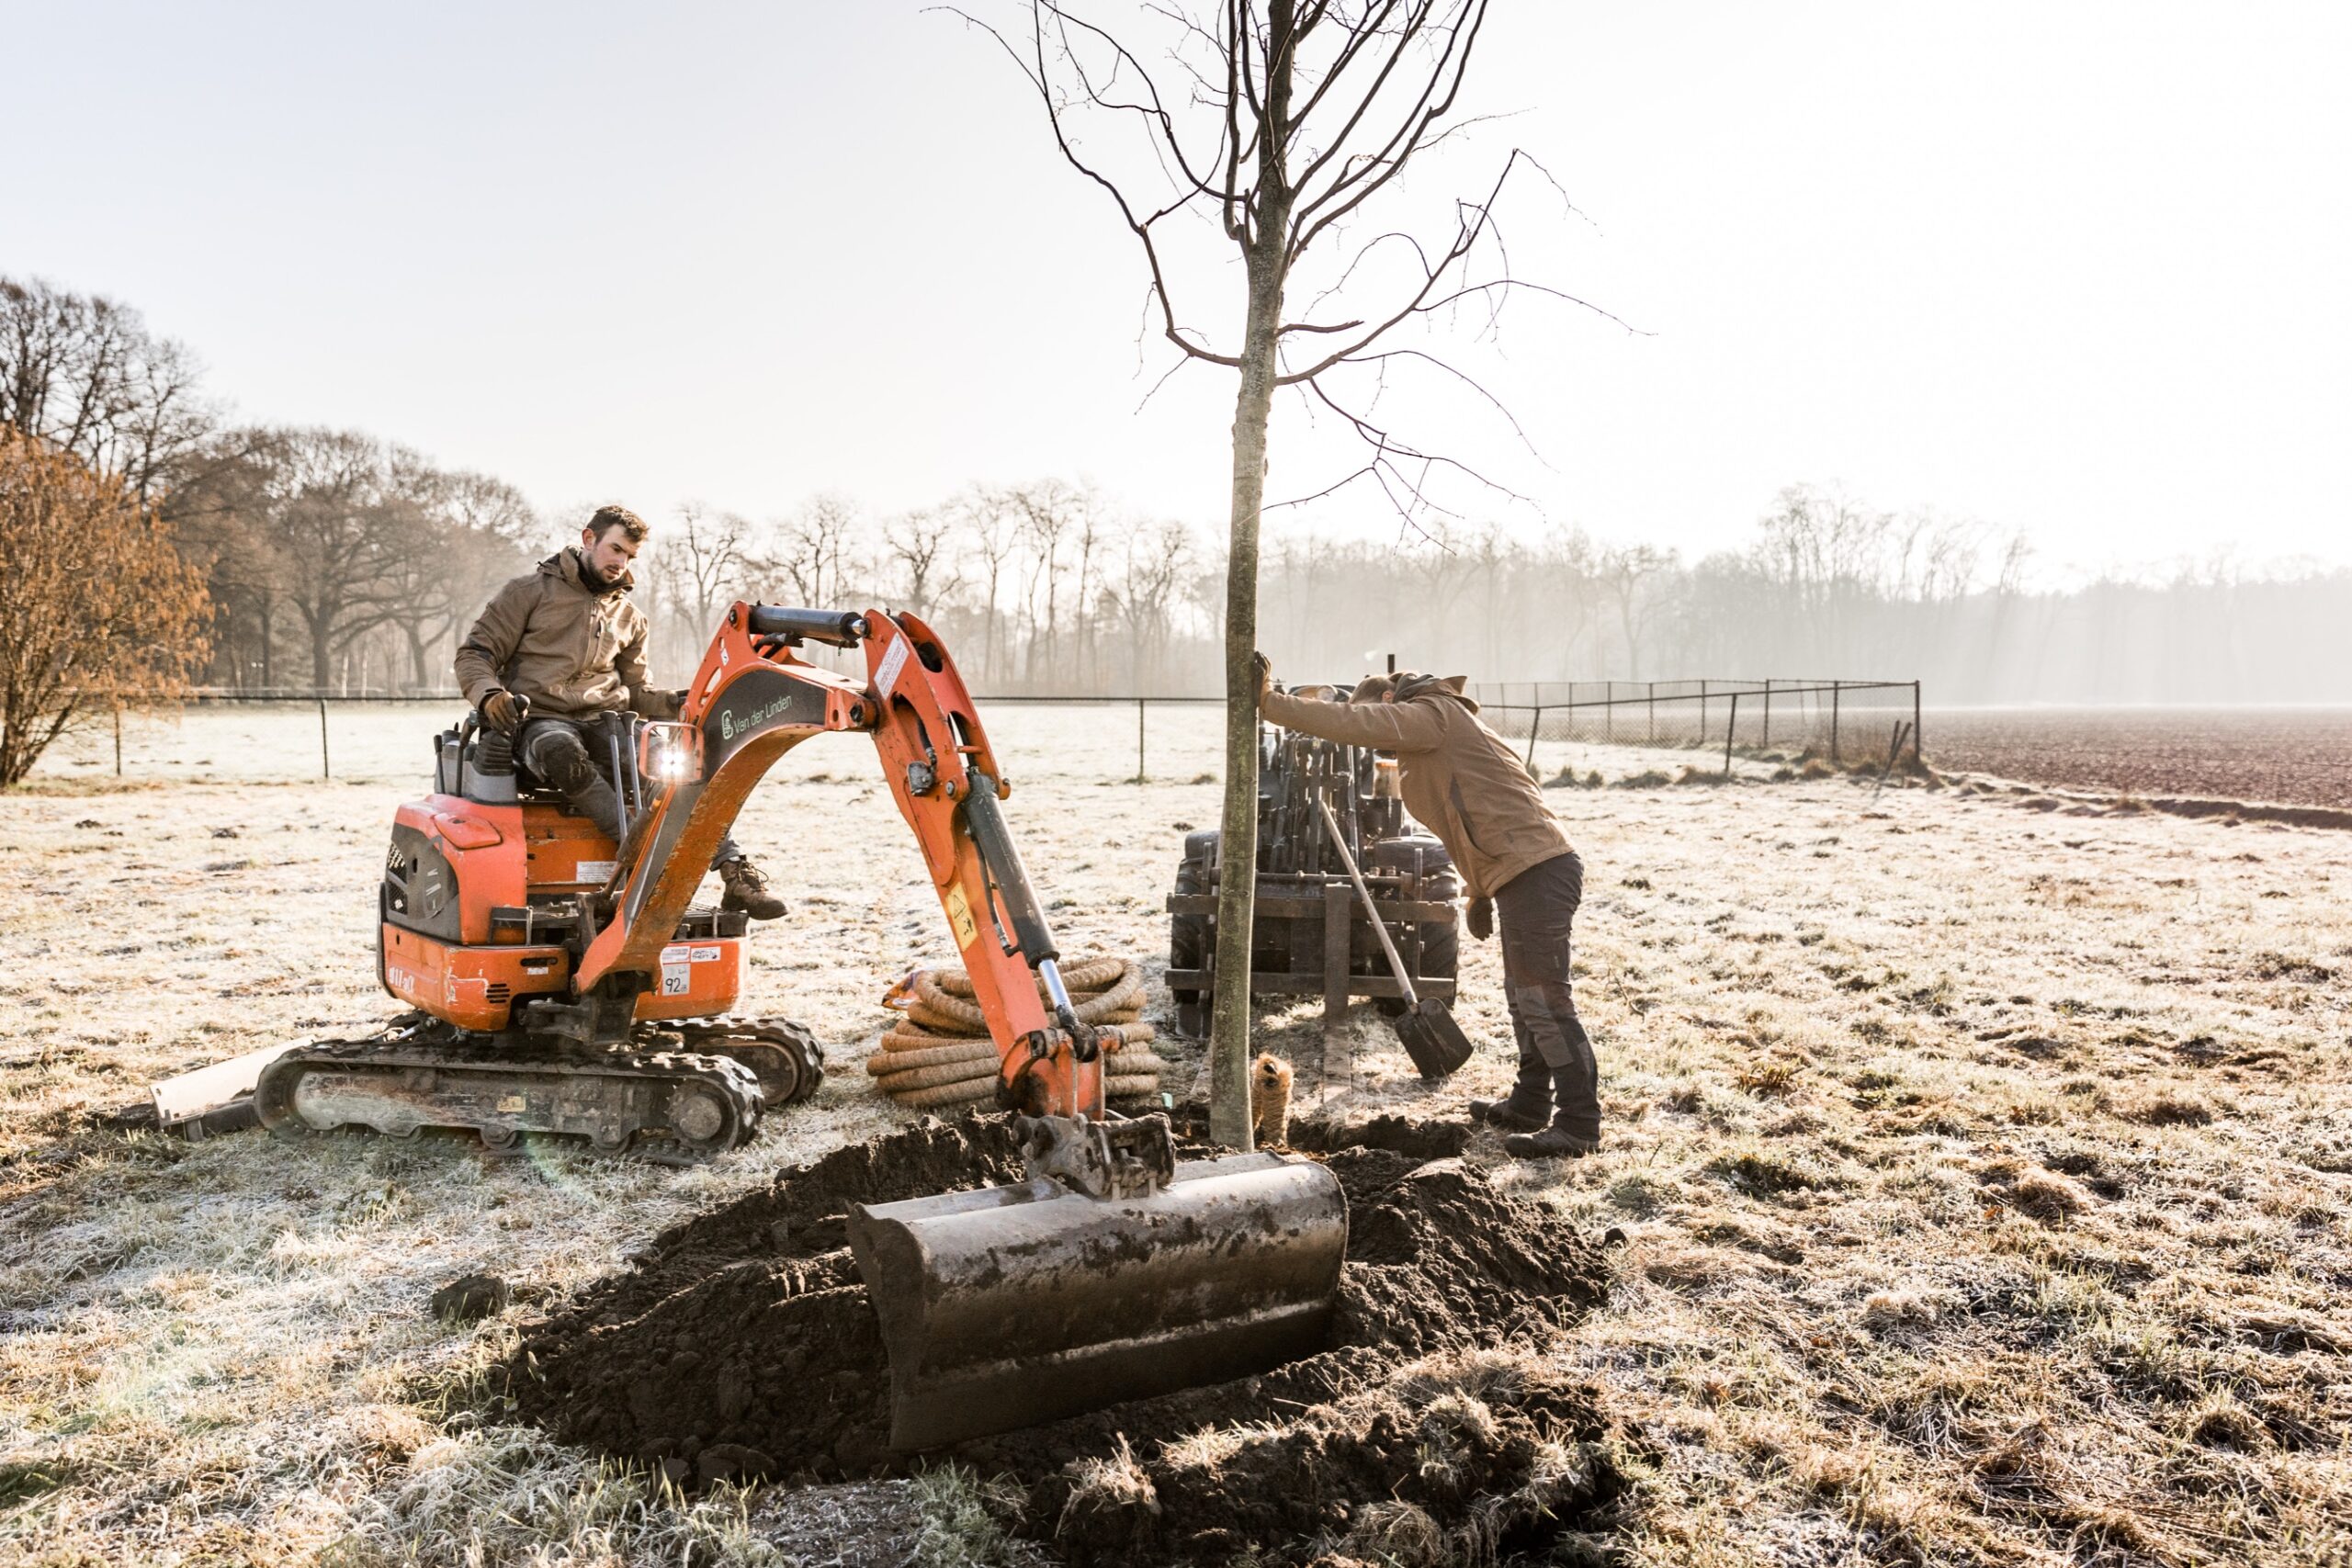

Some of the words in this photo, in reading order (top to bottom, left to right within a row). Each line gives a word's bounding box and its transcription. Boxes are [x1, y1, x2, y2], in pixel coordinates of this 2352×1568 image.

[734, 718, 750, 733] Van
[751, 710, 764, 726] der
[765, 696, 792, 718] Linden
[665, 977, 681, 993] 92
